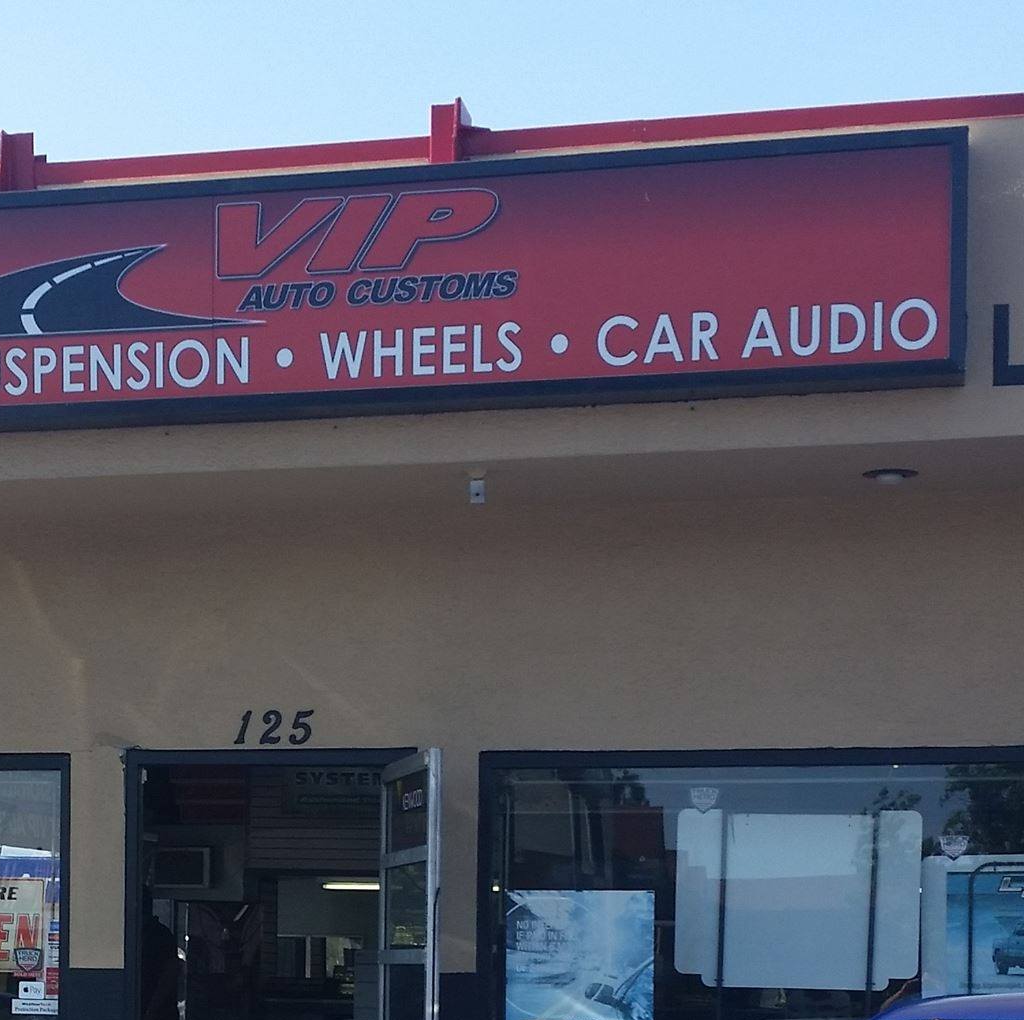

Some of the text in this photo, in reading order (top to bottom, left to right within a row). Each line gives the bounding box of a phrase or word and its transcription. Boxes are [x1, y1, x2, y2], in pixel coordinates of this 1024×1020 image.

[216, 188, 499, 279] VIP
[237, 269, 519, 313] AUTO CUSTOMS
[320, 321, 523, 381] WHEELS
[597, 312, 719, 367] CAR
[741, 298, 938, 360] AUDIO
[233, 709, 315, 745] 125
